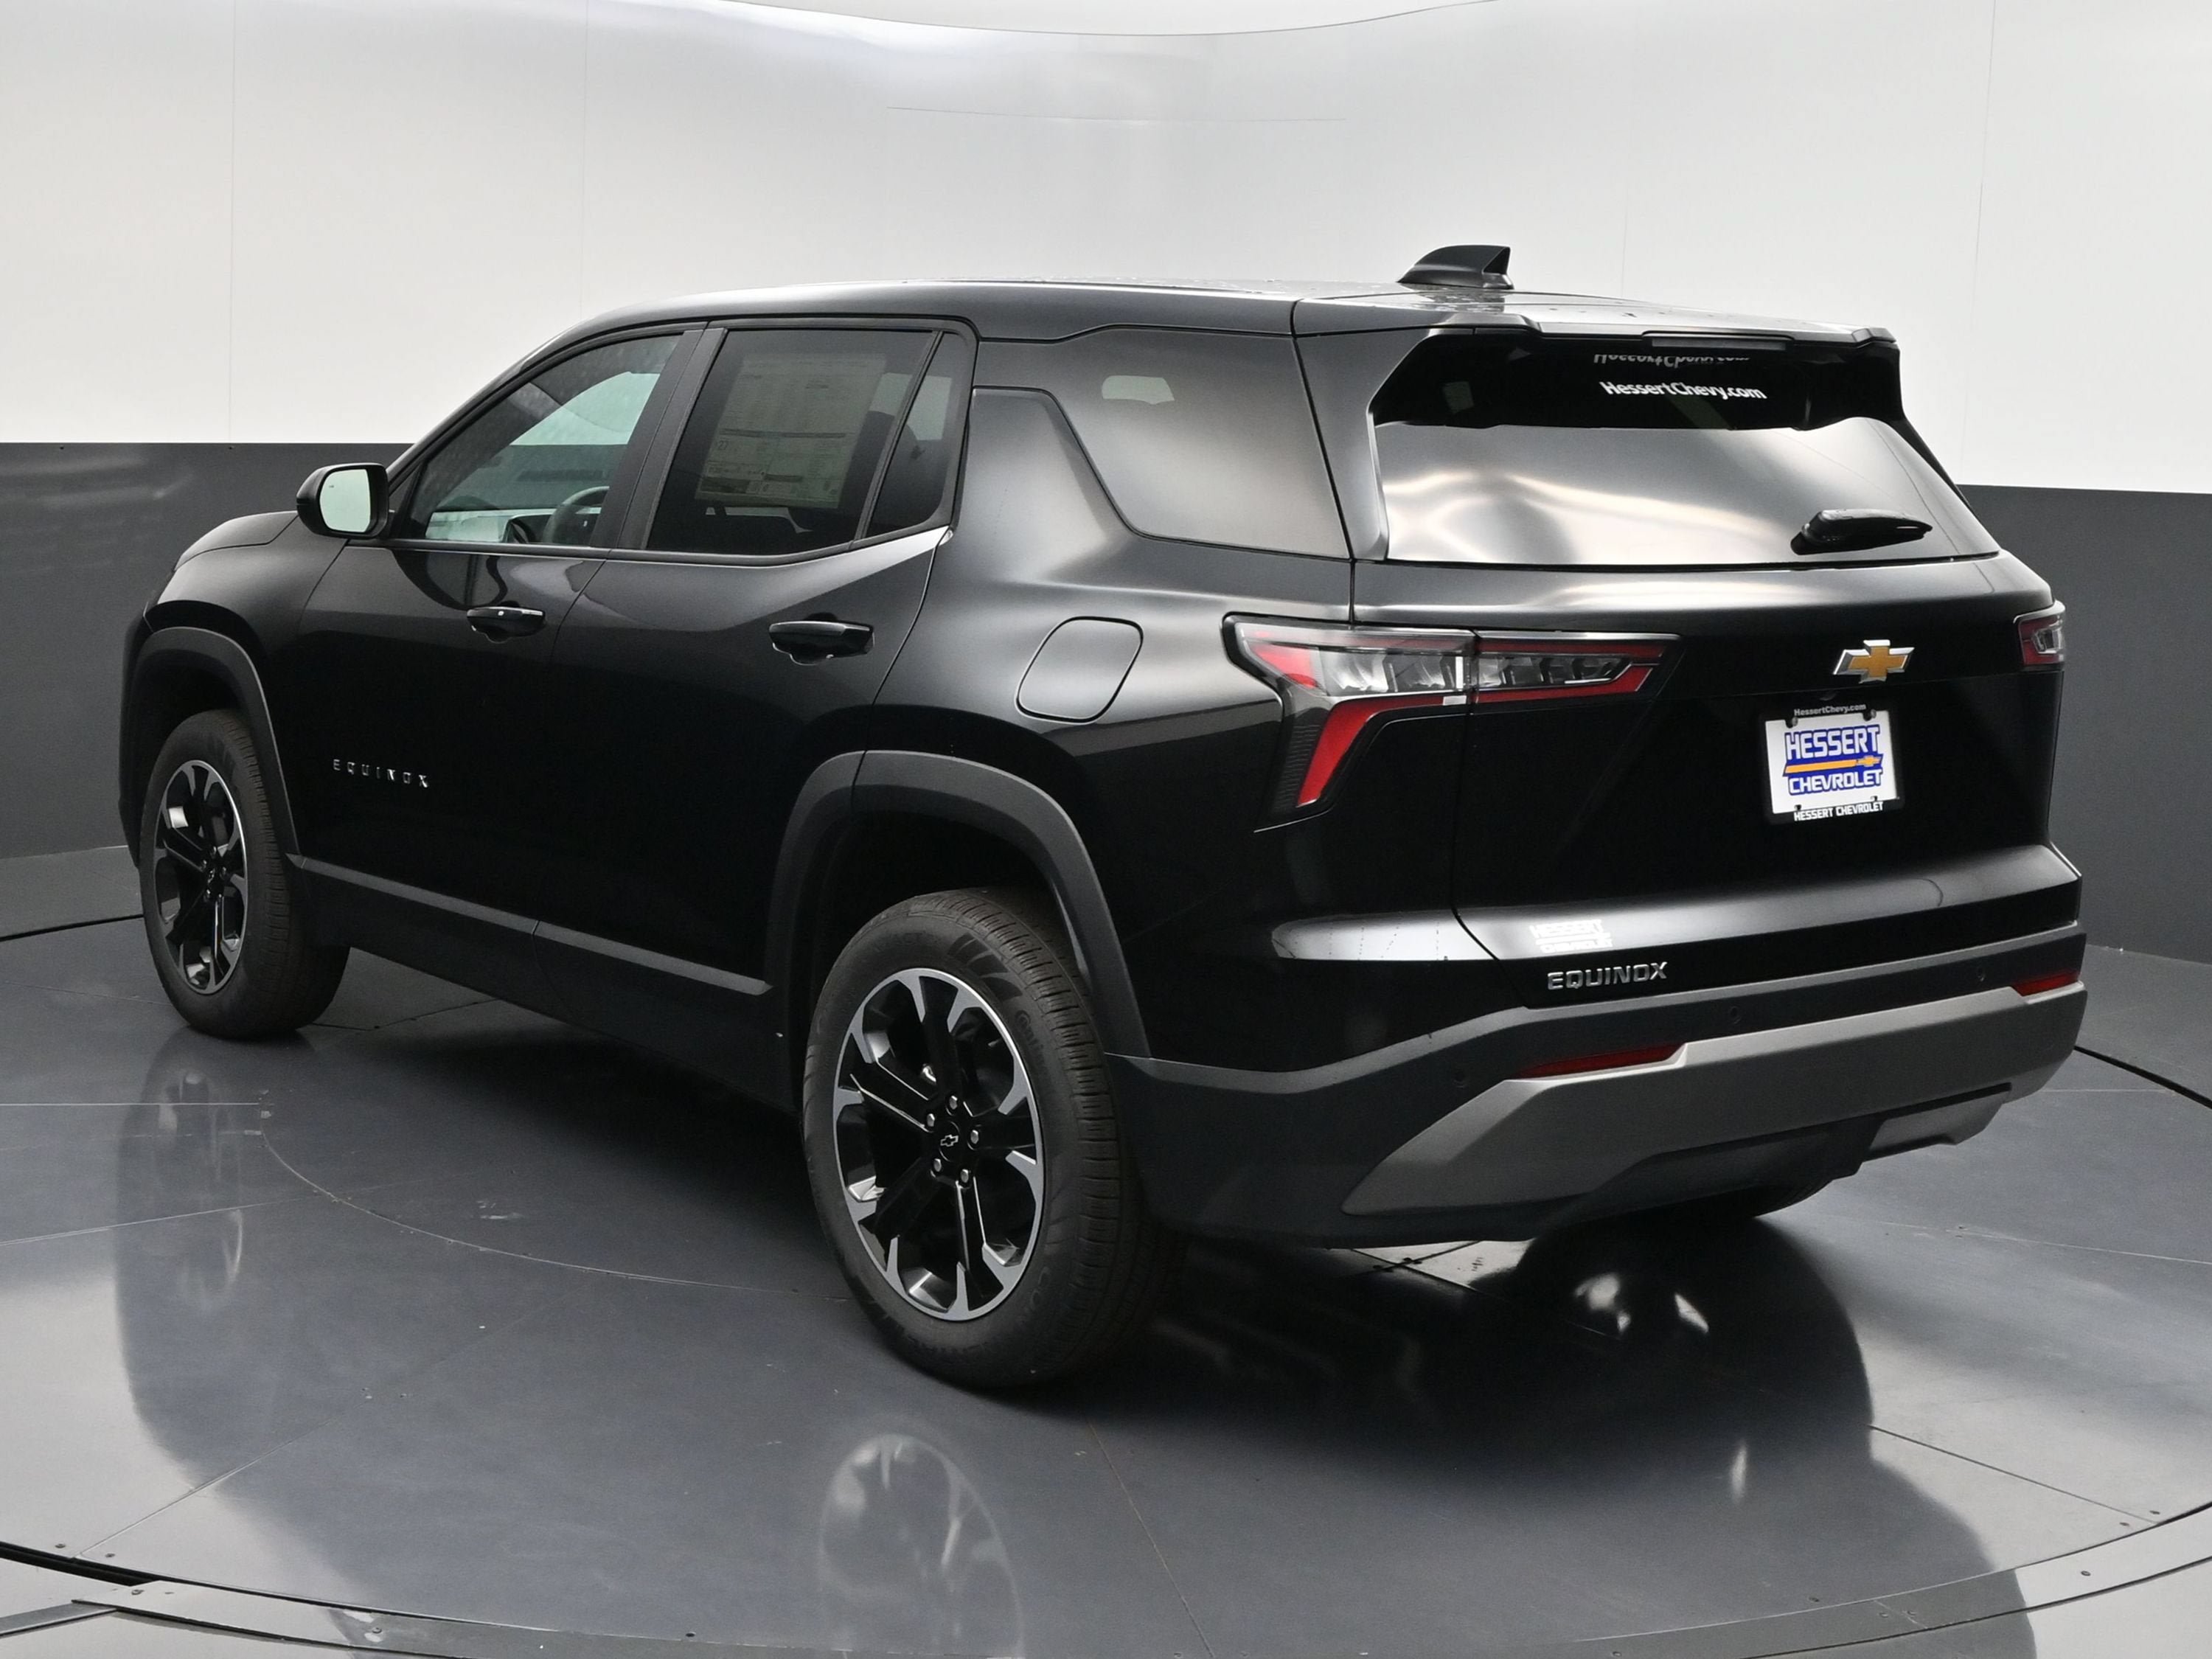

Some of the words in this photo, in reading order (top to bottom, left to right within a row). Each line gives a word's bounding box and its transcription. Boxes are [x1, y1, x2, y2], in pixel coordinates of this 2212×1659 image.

[1599, 380, 1767, 400] HessertChevy.com
[1794, 704, 1866, 716] HessertChevy.com
[1785, 726, 1879, 760] HESSERT
[333, 759, 428, 787] EQUINOX
[1788, 769, 1882, 794] CHEVROLET
[1794, 808, 1833, 821] HESSERT
[1836, 802, 1883, 816] CHEVROLET
[1547, 961, 1668, 990] EQUINOX
